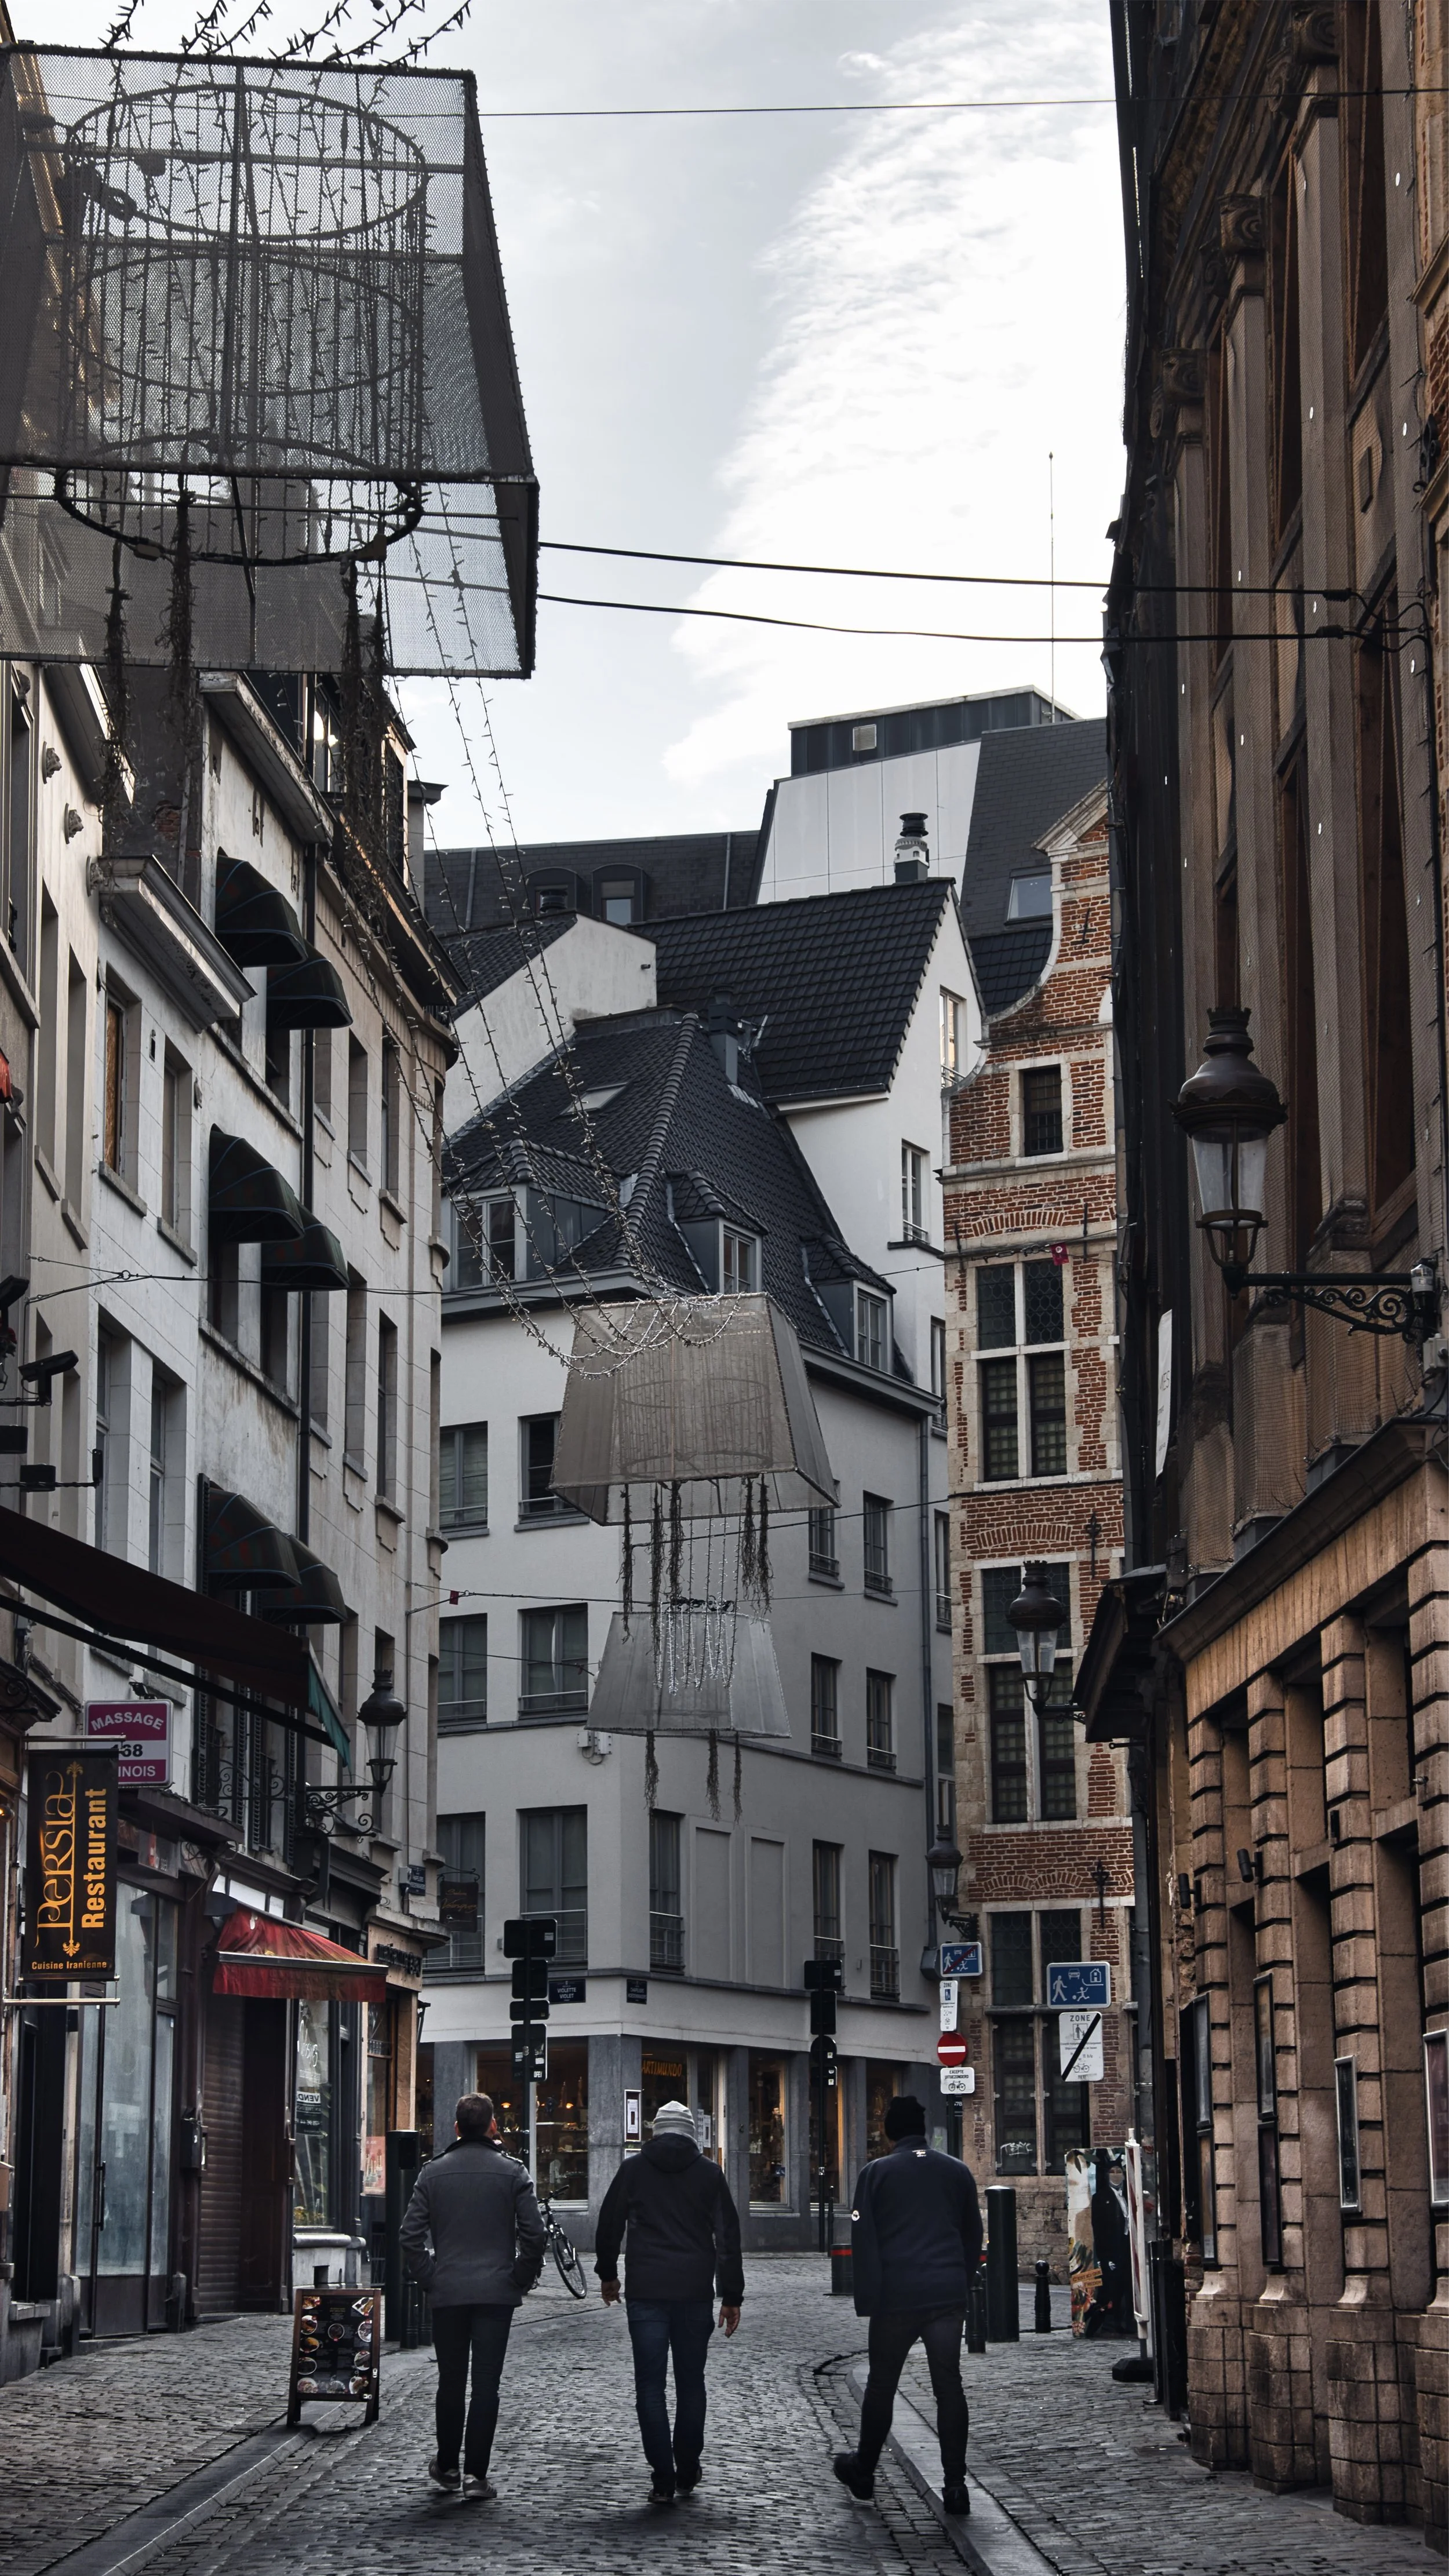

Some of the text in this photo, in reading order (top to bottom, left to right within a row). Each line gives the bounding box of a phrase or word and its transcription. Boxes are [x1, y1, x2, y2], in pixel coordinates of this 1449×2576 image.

[90, 1712, 164, 1731] MASSAGE
[118, 1766, 156, 1777] INOIS
[82, 1788, 107, 1928] Restaurant
[32, 1961, 107, 1970] Cuisine Iranienne
[642, 2060, 683, 2077] ARTIMUNDO
